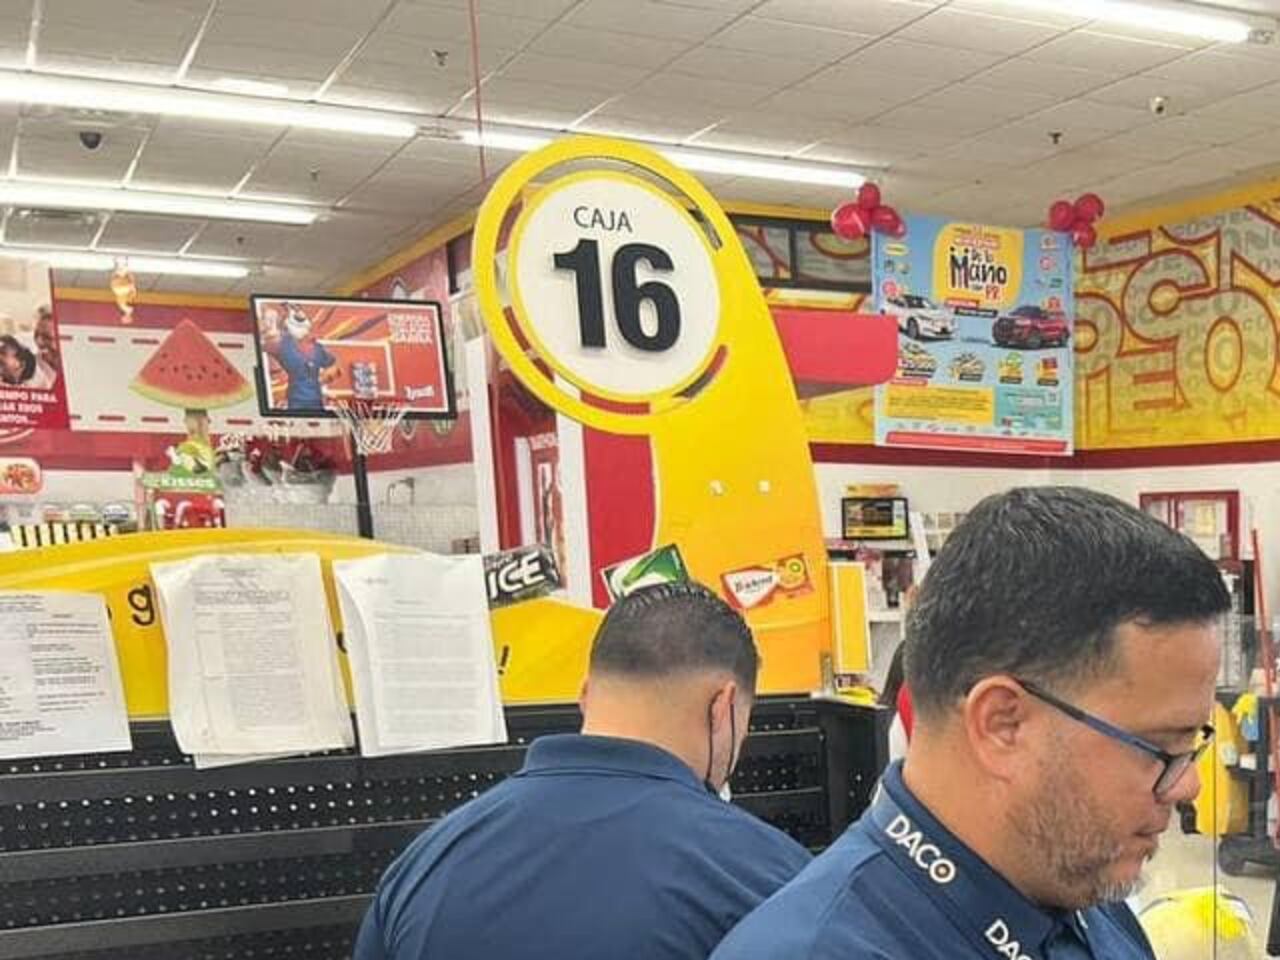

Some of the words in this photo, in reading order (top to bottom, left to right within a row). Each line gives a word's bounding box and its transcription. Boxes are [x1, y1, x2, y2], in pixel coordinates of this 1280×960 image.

[573, 206, 633, 233] CAJA
[553, 238, 681, 353] 16
[488, 551, 546, 600] ICE
[885, 814, 957, 884] DACO
